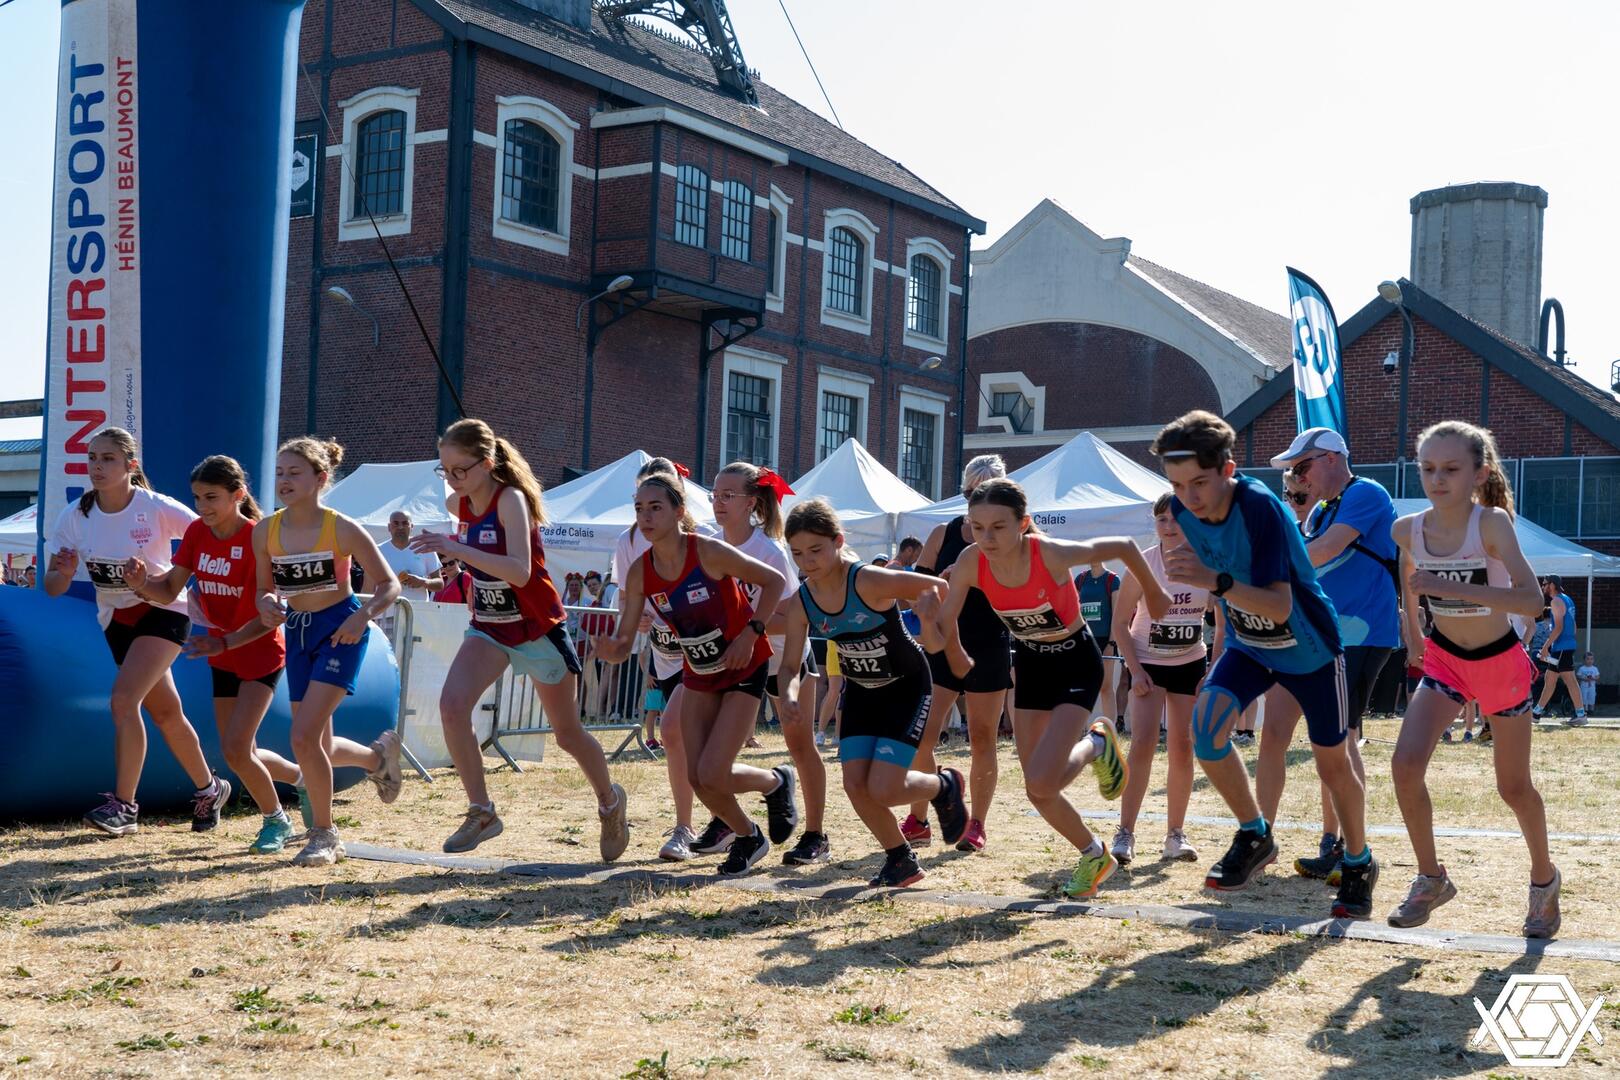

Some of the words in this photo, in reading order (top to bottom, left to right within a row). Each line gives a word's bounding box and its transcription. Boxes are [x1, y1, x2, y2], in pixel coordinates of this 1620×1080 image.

[116, 56, 134, 190] BEAUMONT
[114, 198, 135, 271] HÉNIN
[64, 53, 106, 475] INTERSPORT
[126, 373, 136, 438] joignez-nous
[555, 526, 567, 536] de
[568, 527, 594, 538] Calais
[106, 565, 124, 578] 30
[197, 552, 231, 577] Hello
[291, 561, 325, 579] 314
[479, 588, 506, 605] 305
[1167, 608, 1179, 616] SSE
[1012, 614, 1048, 629] 308
[1240, 614, 1275, 631] 309
[656, 630, 679, 645] 304
[1167, 626, 1194, 640] 310
[688, 641, 719, 659] 313
[1040, 639, 1076, 653] PRO
[850, 658, 881, 672] 312
